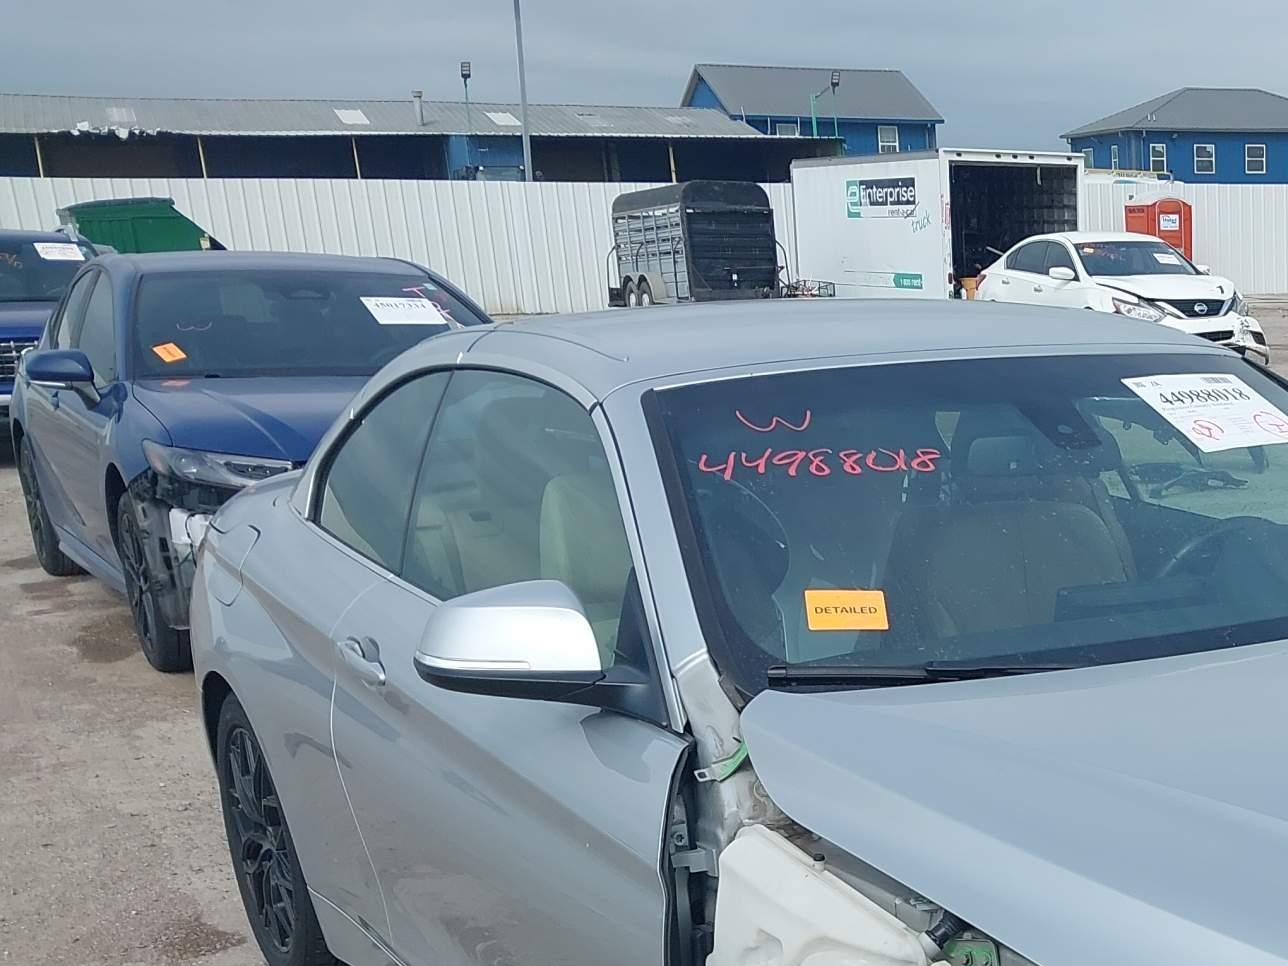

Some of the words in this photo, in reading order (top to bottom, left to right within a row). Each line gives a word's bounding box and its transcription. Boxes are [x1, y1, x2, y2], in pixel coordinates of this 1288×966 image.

[860, 181, 914, 206] Enterprise
[912, 211, 931, 233] truck
[1159, 387, 1251, 406] 44988018
[697, 447, 941, 481] 44988018
[814, 605, 878, 615] DETAILED
